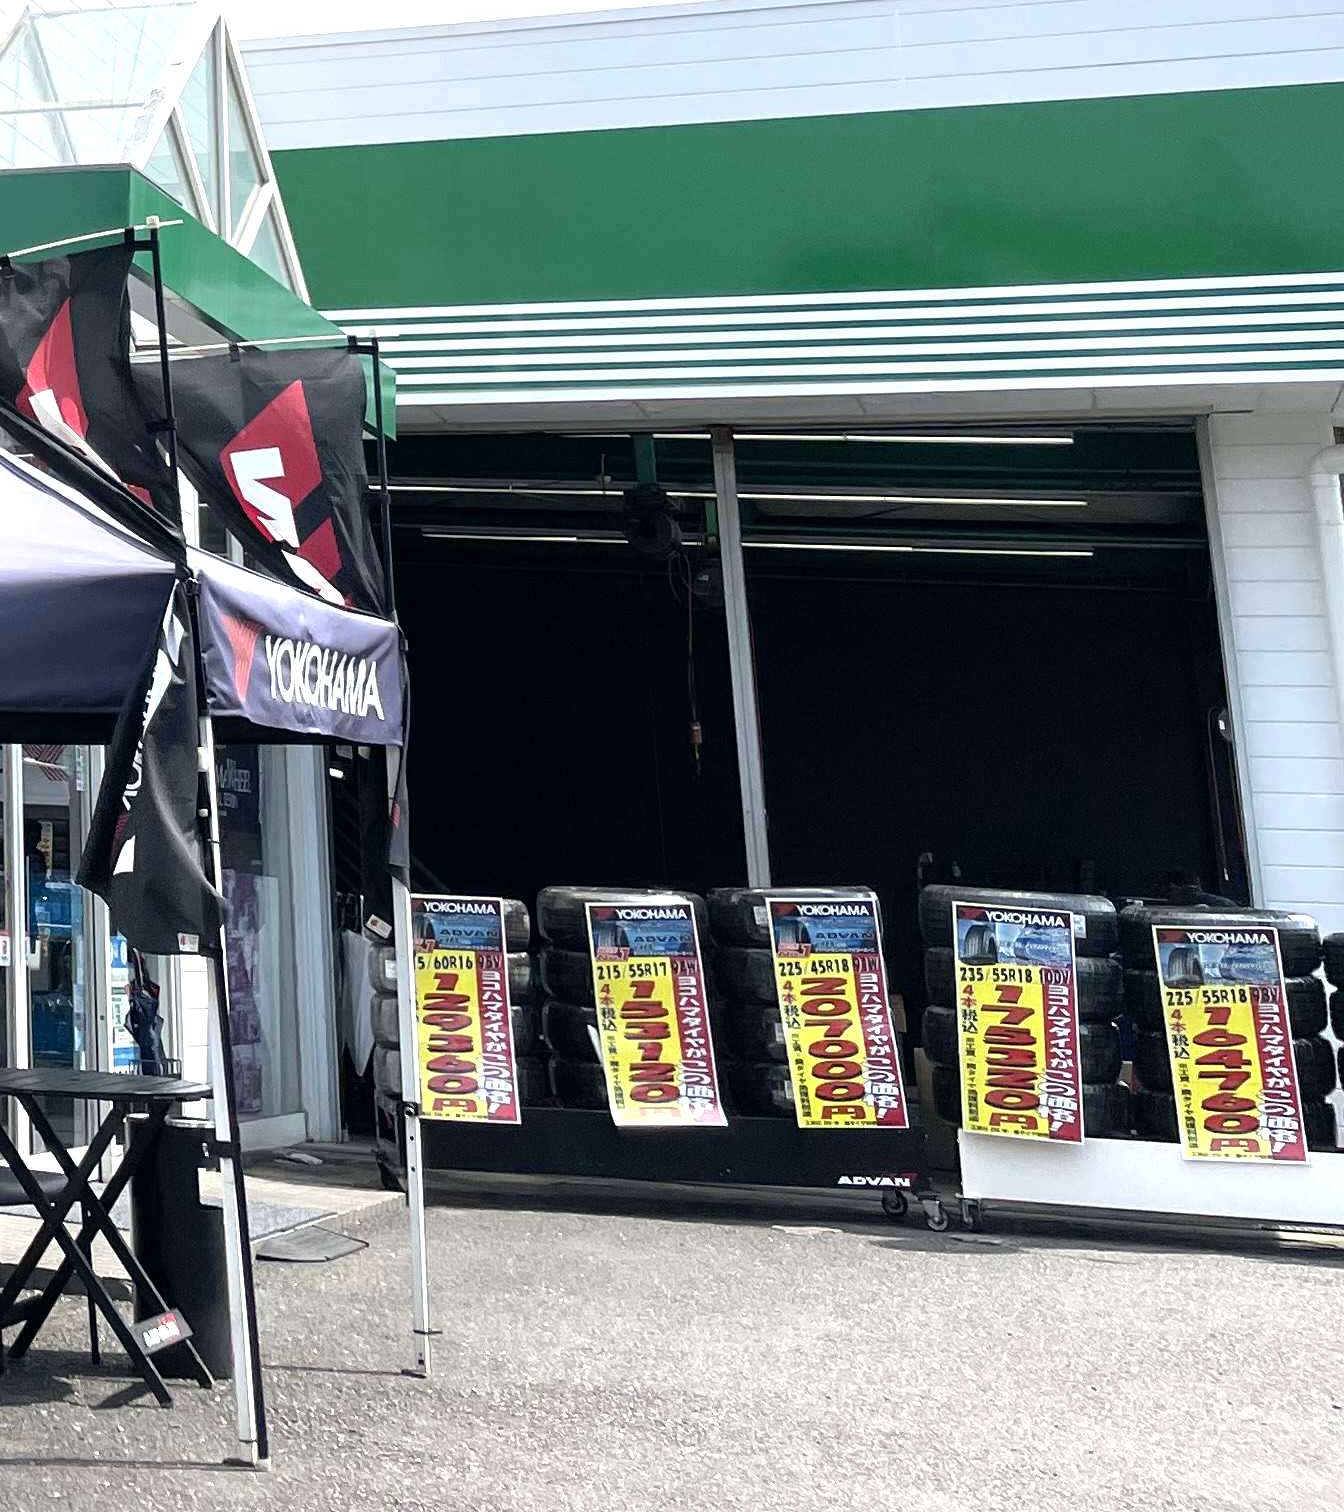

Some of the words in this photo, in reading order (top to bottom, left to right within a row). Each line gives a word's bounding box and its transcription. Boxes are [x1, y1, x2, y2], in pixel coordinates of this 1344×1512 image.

[265, 635, 386, 721] YOKOHAMA
[424, 901, 496, 914] YOKOHAMA
[616, 908, 687, 920] YOKOHAMA
[796, 905, 869, 916] YOKOHAMA
[985, 910, 1065, 928] YOKOHAMA
[1185, 932, 1270, 944] YOKOHAMA
[597, 962, 667, 980] 215/55R17
[778, 958, 849, 977] 225/45R18
[959, 967, 1032, 983] 235/55R18
[1165, 988, 1248, 1006] 225/55R18
[800, 977, 867, 1119] 207000円
[981, 984, 1040, 1130] 175320円
[1193, 1006, 1261, 1153] 164760円
[837, 1175, 911, 1186] ADVAN
